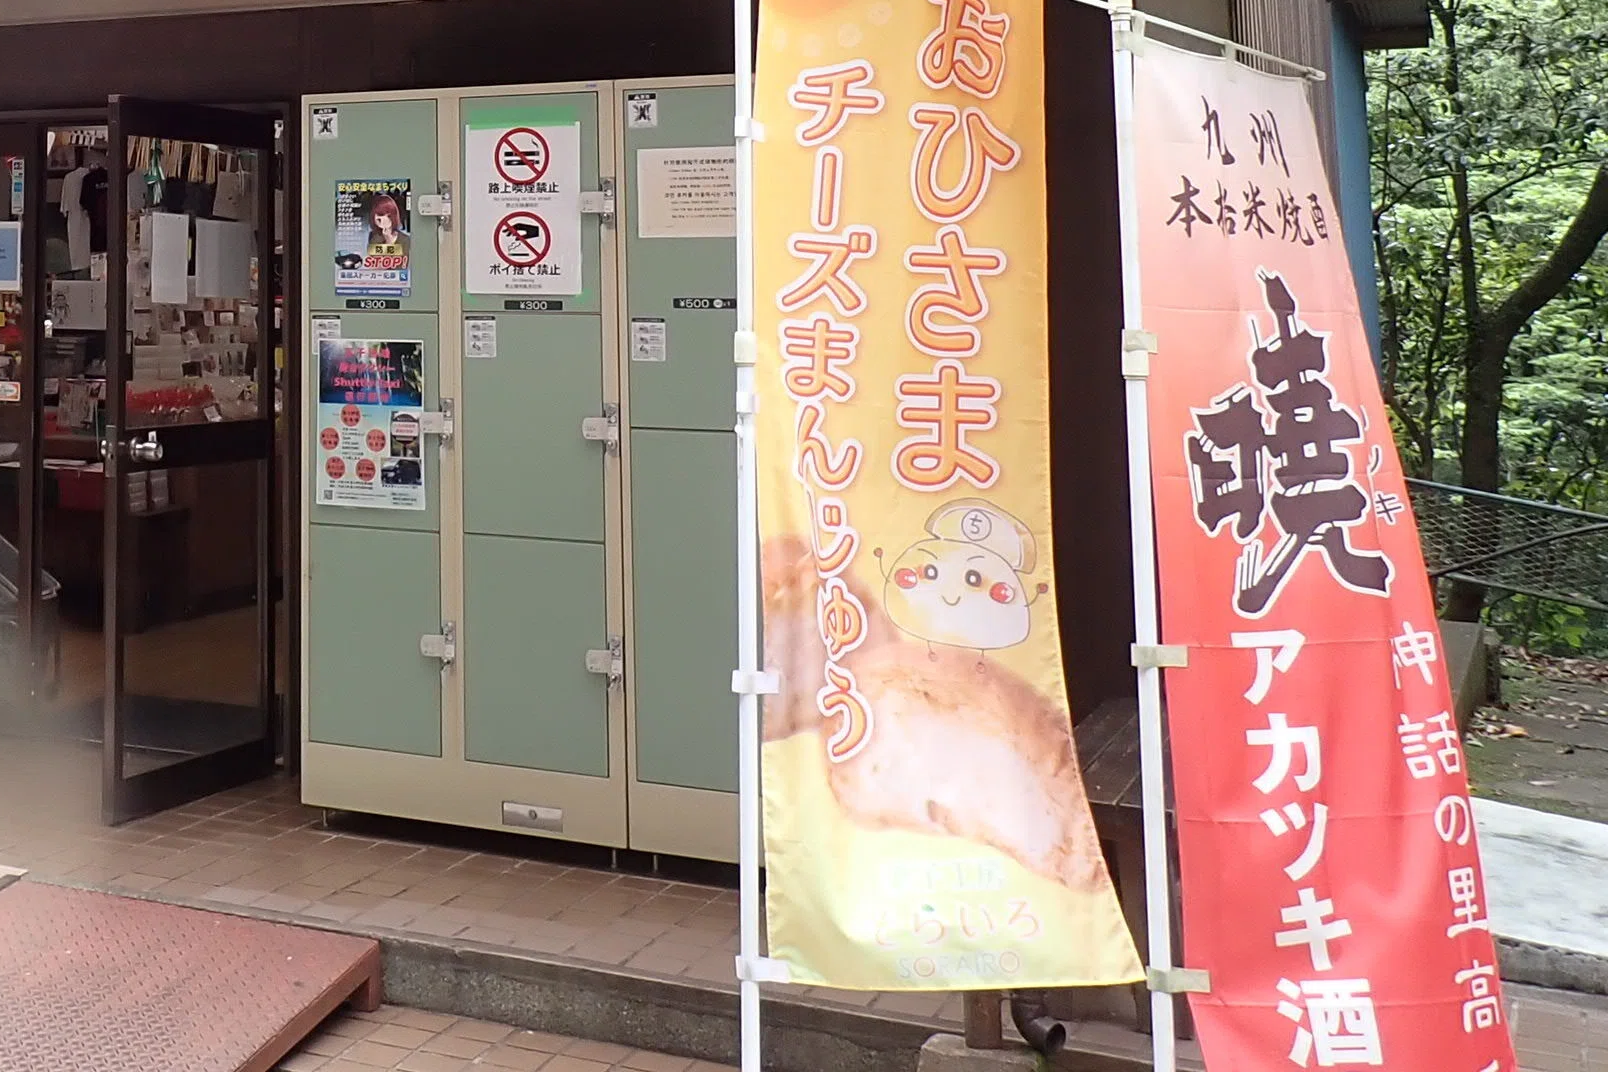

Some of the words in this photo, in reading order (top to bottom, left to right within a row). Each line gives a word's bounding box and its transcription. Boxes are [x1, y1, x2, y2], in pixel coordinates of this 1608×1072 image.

[1201, 95, 1290, 178] 九州
[338, 182, 409, 192] 安心安全なまちづくり
[488, 181, 560, 194] 路上喫煙禁止
[364, 255, 409, 269] STOP!
[489, 263, 561, 276] ポイ捨て禁止
[360, 300, 386, 309] ¥300
[519, 301, 548, 310] ¥300
[679, 299, 710, 309] ¥500
[775, 59, 885, 763] チーズまんじゅう
[969, 513, 983, 535] ち
[1230, 628, 1383, 1068] アカツキ酒
[1390, 621, 1501, 1072] 神話の里高
[898, 950, 1021, 979] SORAIRO
